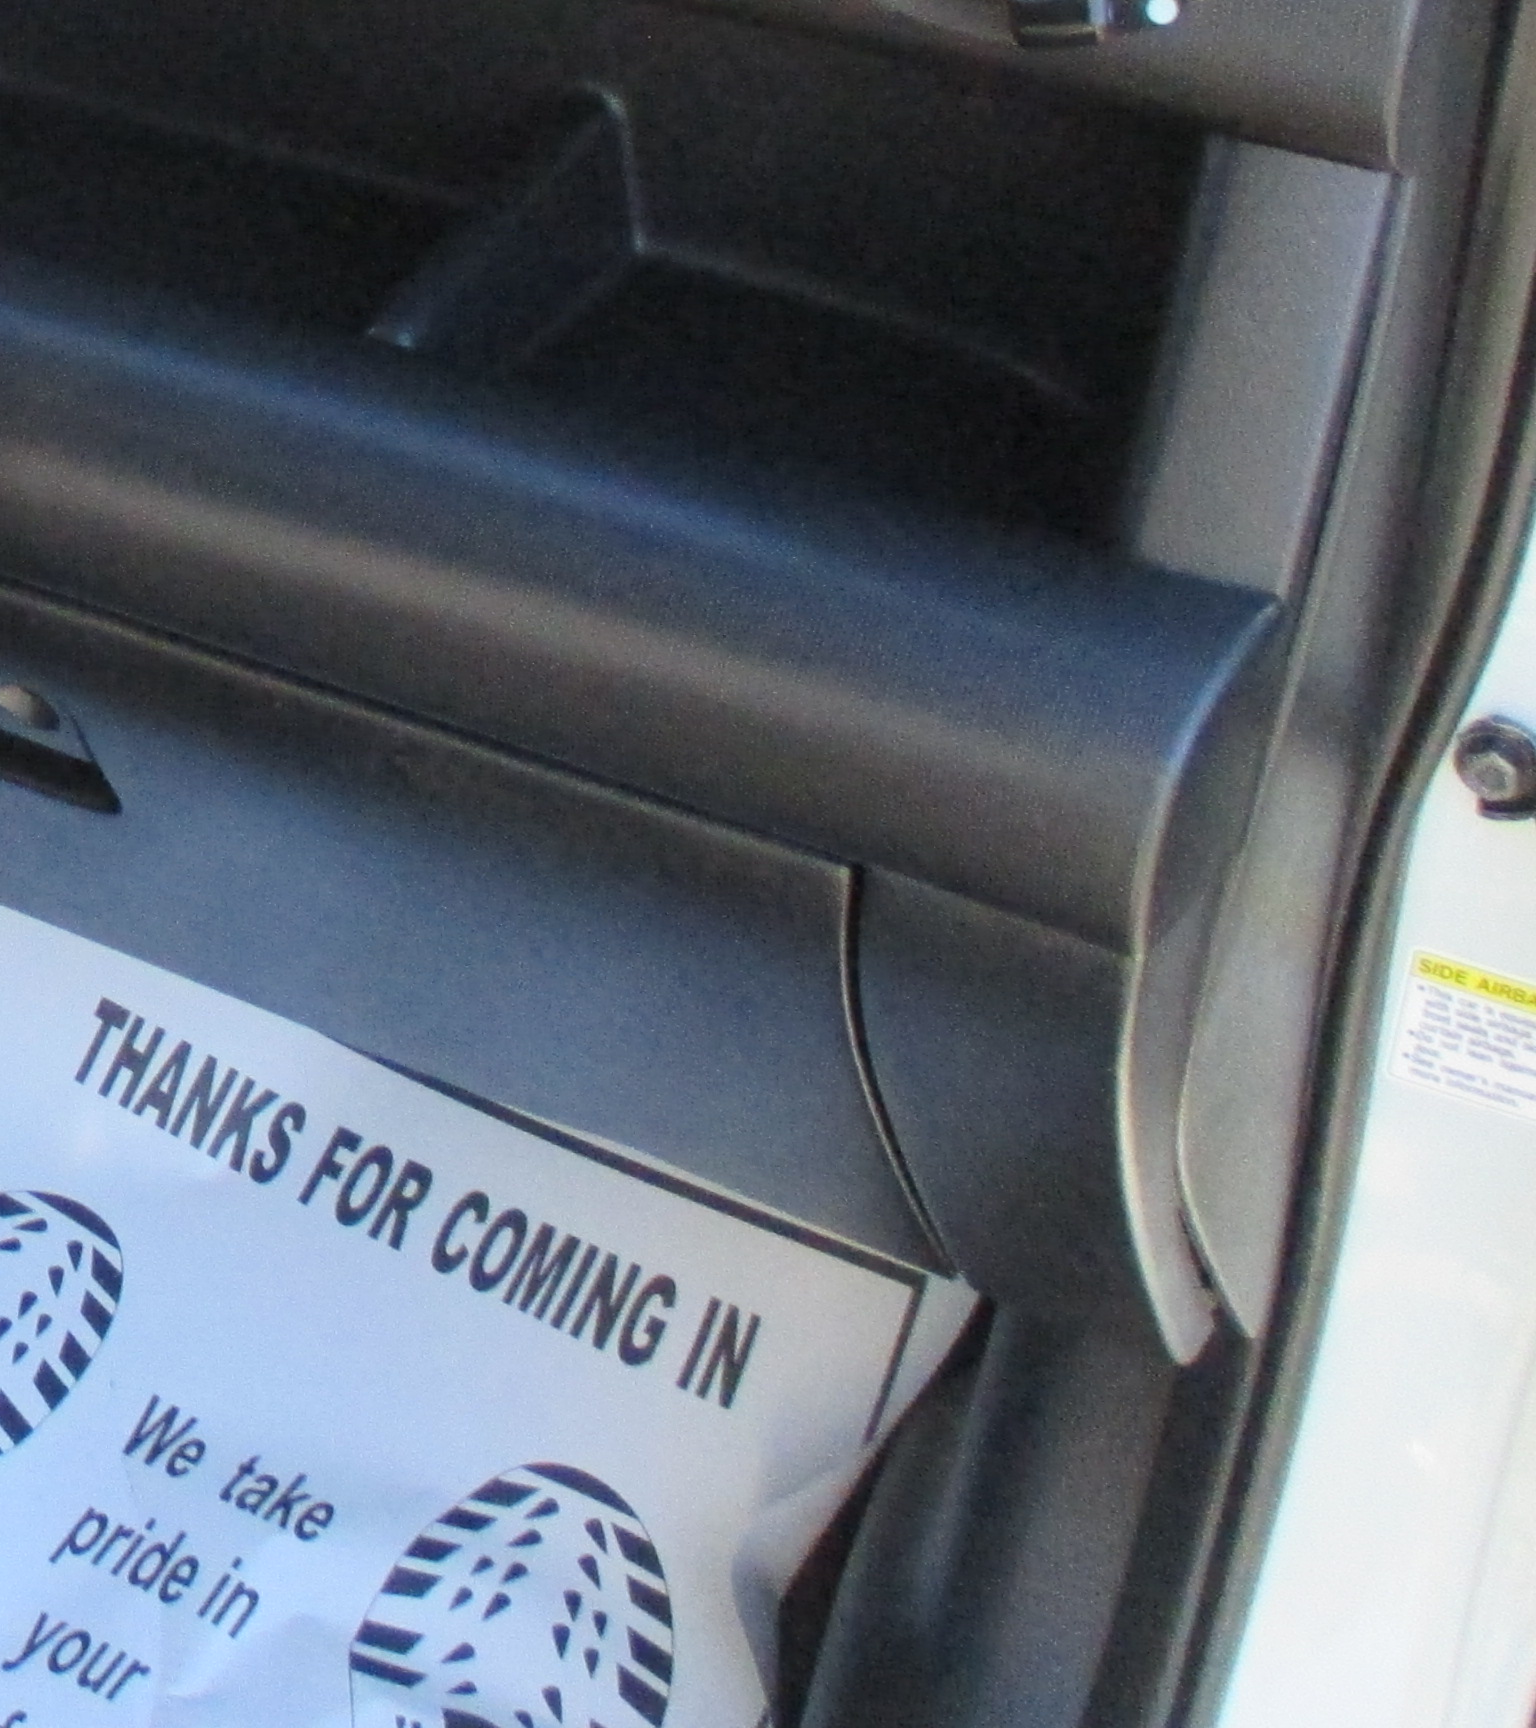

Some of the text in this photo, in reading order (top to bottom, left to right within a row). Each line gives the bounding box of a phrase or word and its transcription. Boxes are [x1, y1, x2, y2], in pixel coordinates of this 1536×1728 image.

[1418, 958, 1468, 986] SIDE
[74, 996, 760, 1410] THANKS FOR COMING IN
[122, 1394, 335, 1542] We take
[49, 1506, 260, 1639] pride in
[1, 1612, 151, 1701] your
